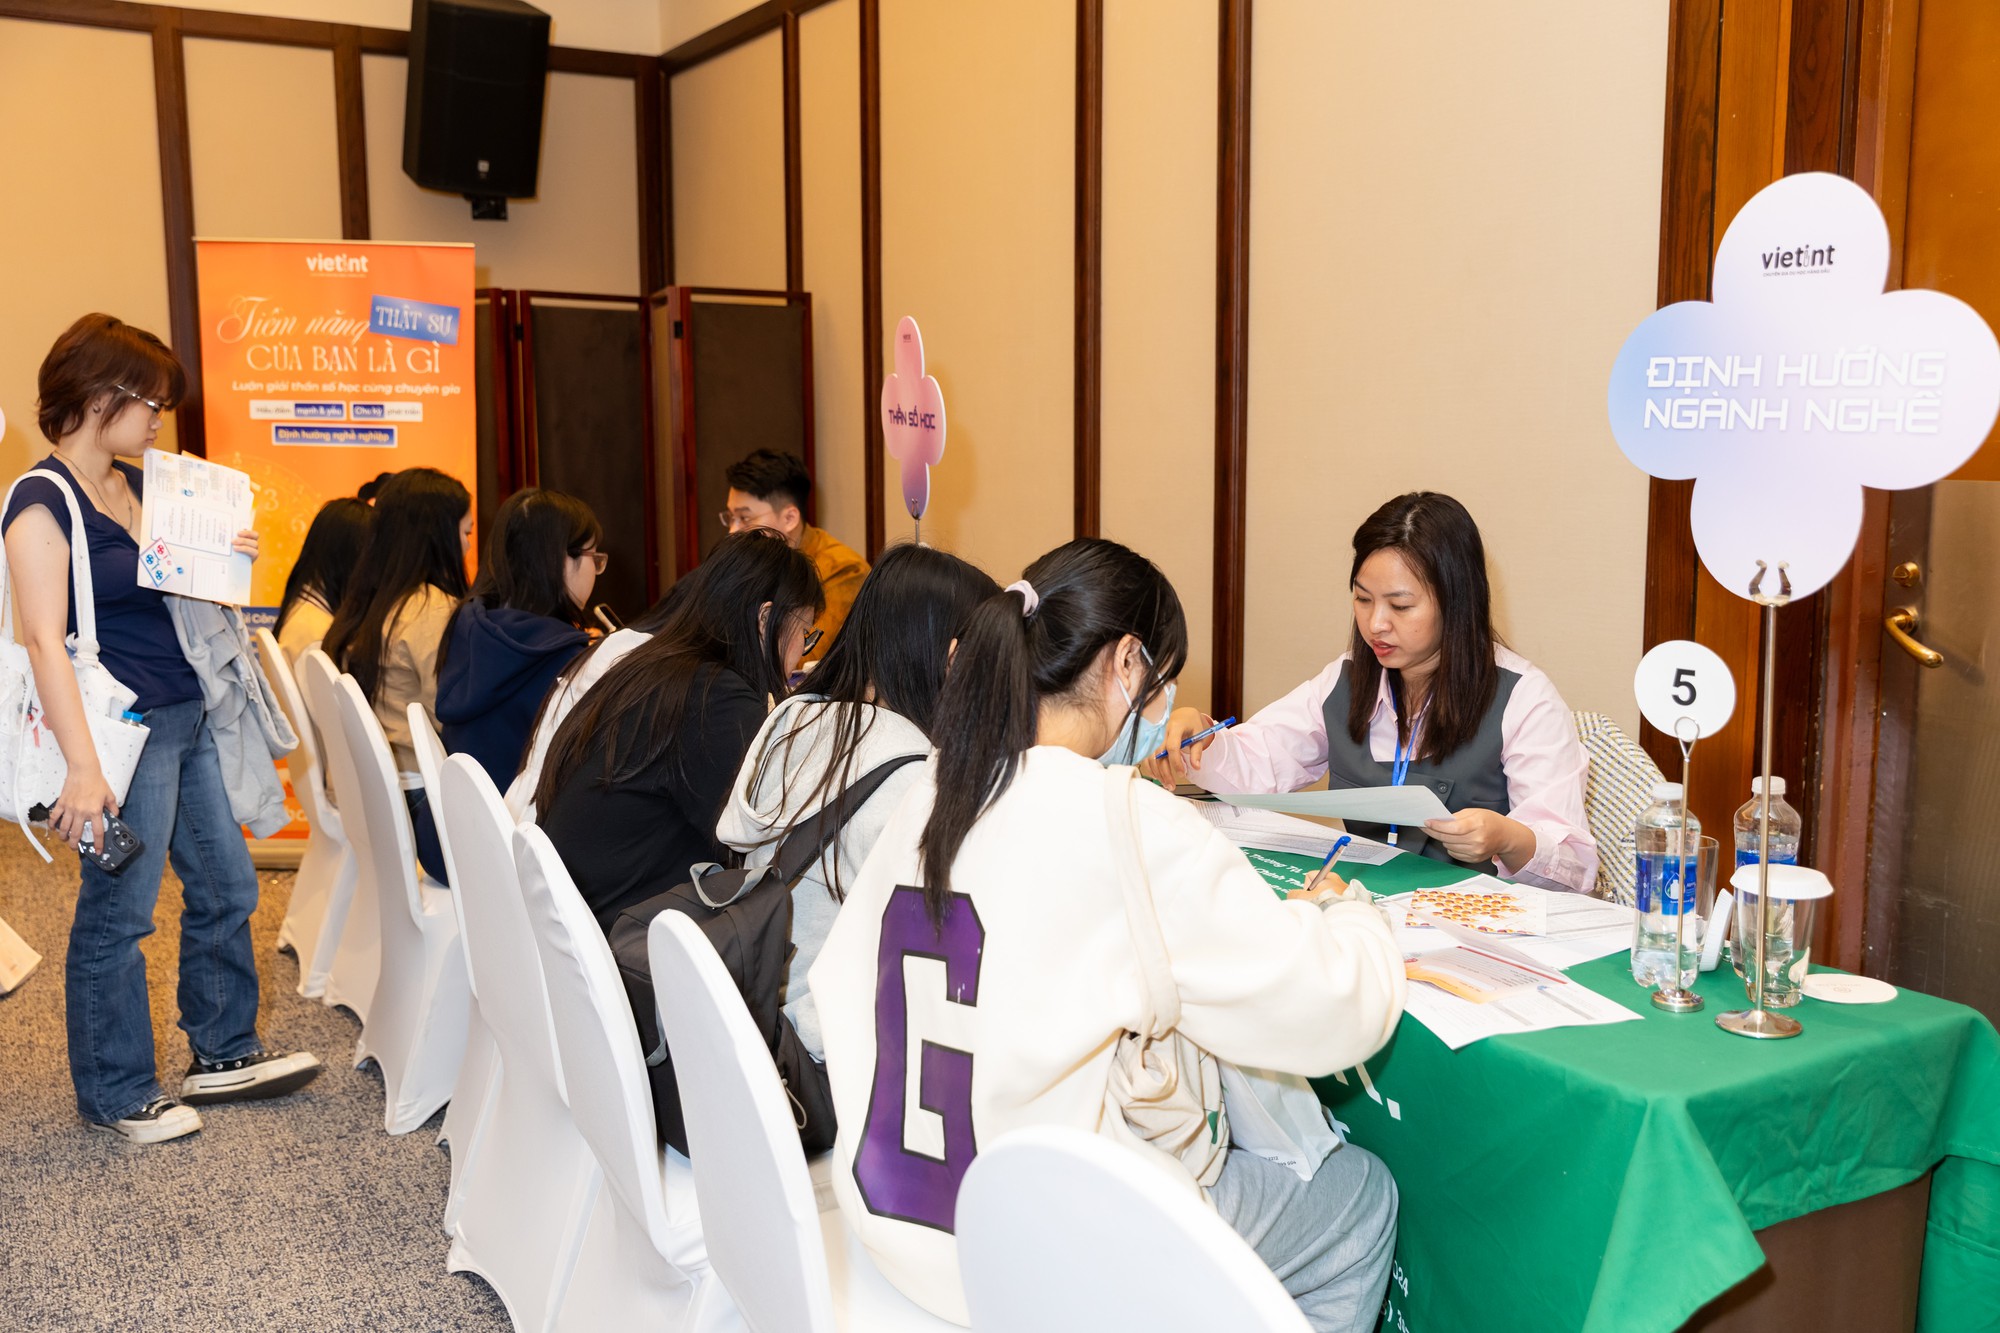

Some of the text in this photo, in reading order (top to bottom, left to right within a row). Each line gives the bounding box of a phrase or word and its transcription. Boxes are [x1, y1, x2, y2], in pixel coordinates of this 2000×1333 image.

[306, 252, 369, 273] vietint
[1762, 244, 1836, 270] vietint
[304, 308, 371, 345] năng
[246, 338, 440, 375] CỦA BẠN LÀ GÌ
[1646, 345, 1946, 395] ĐỊNH HƯỚNG
[1643, 389, 1943, 434] NGÀNH NGHỀ
[1672, 668, 1698, 706] 5
[852, 884, 985, 1235] G
